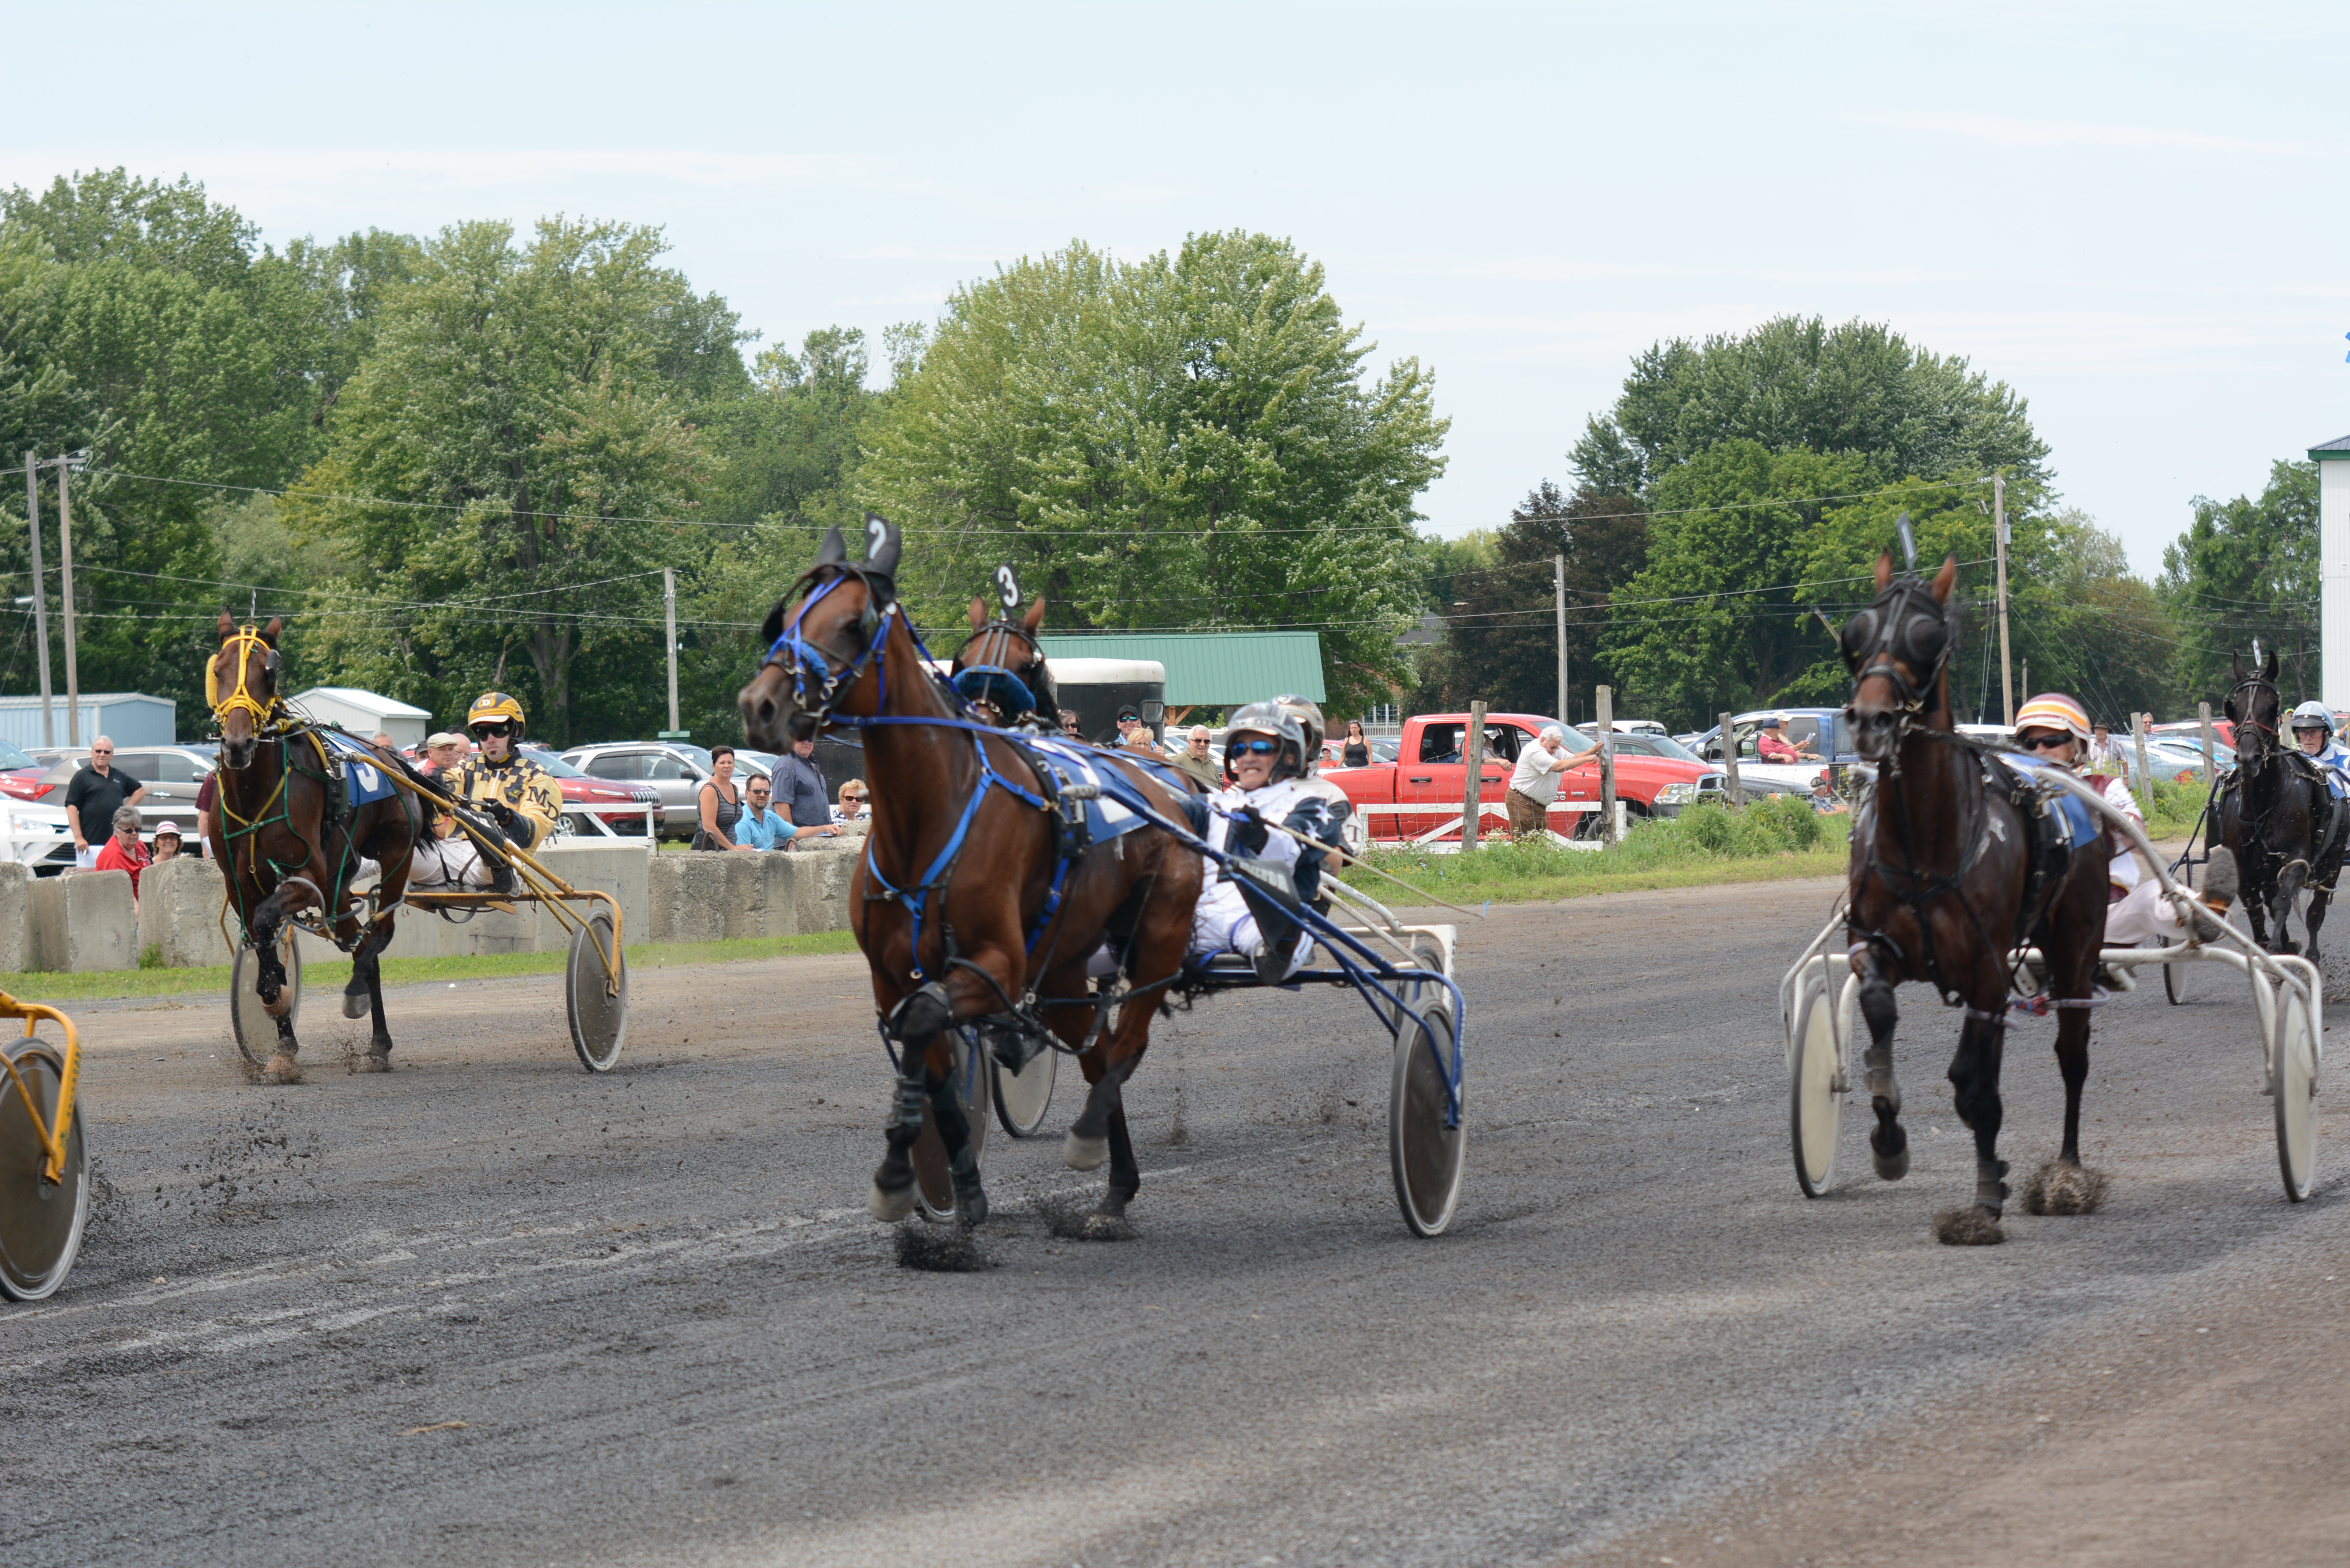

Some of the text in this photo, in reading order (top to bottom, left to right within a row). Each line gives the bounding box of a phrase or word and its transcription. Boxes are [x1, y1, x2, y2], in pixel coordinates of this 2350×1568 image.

[1902, 523, 1914, 560] 1
[998, 565, 1019, 607] 3
[2253, 639, 2262, 666] 6
[1346, 824, 1363, 844] T
